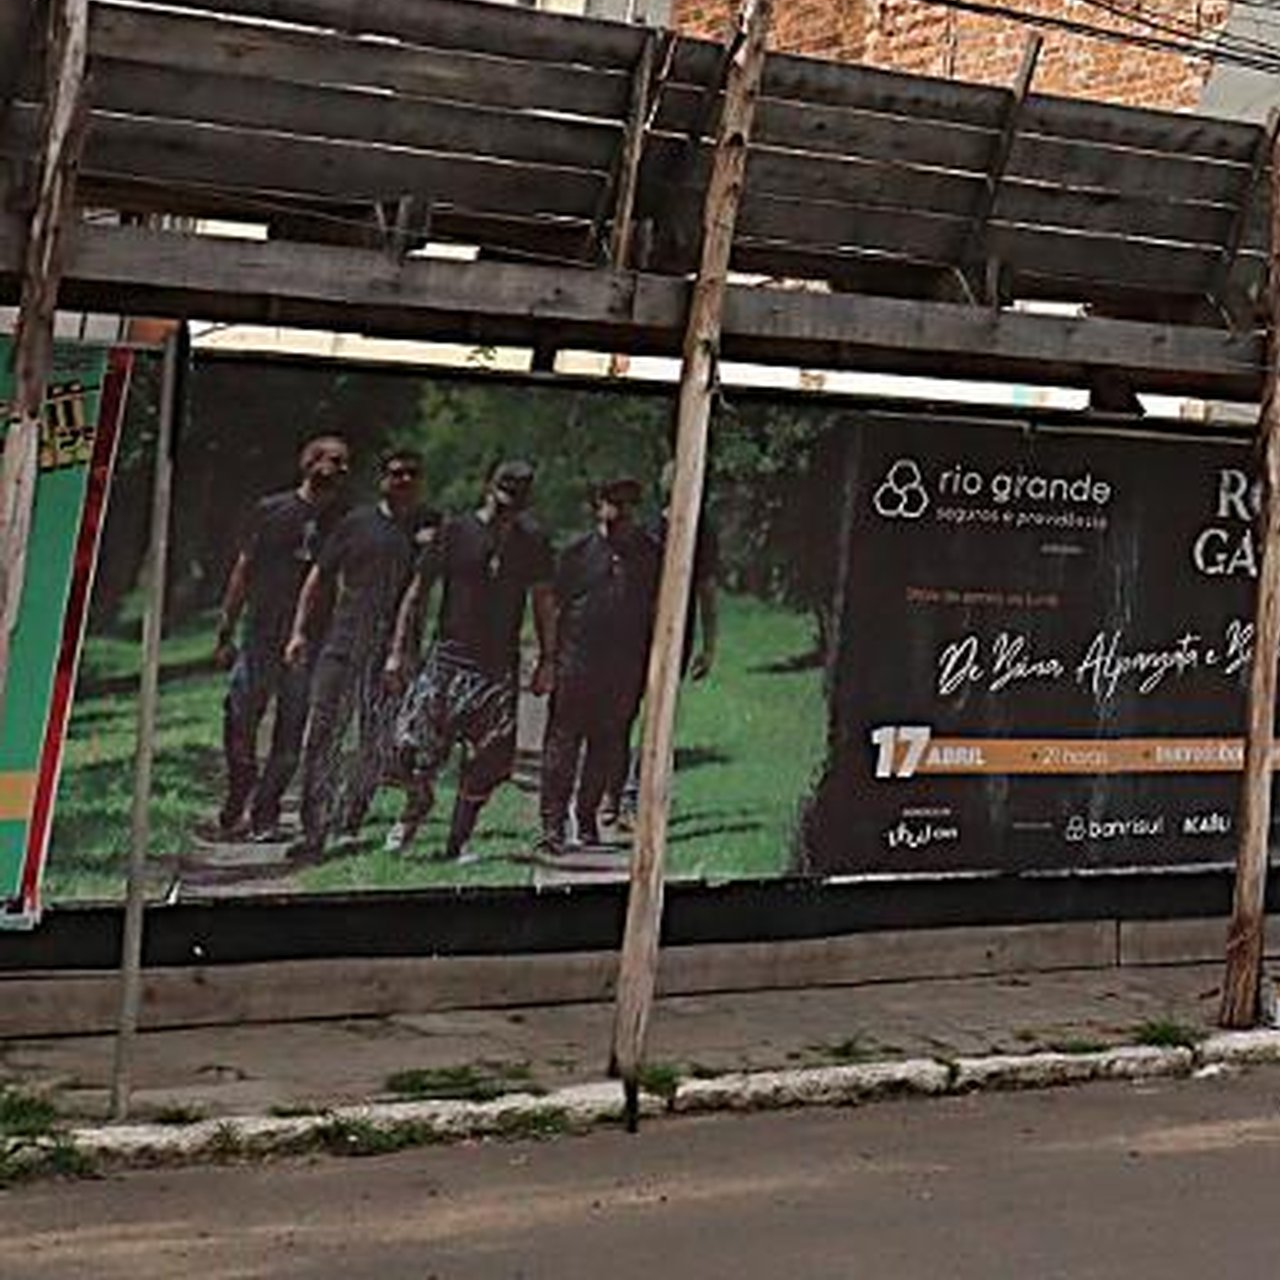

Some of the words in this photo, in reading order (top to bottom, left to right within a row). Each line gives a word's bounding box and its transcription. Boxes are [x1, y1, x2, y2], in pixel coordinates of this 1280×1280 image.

[937, 464, 983, 495] rio
[990, 472, 1111, 505] grande
[871, 726, 932, 778] 17
[926, 746, 987, 767] ABRIL
